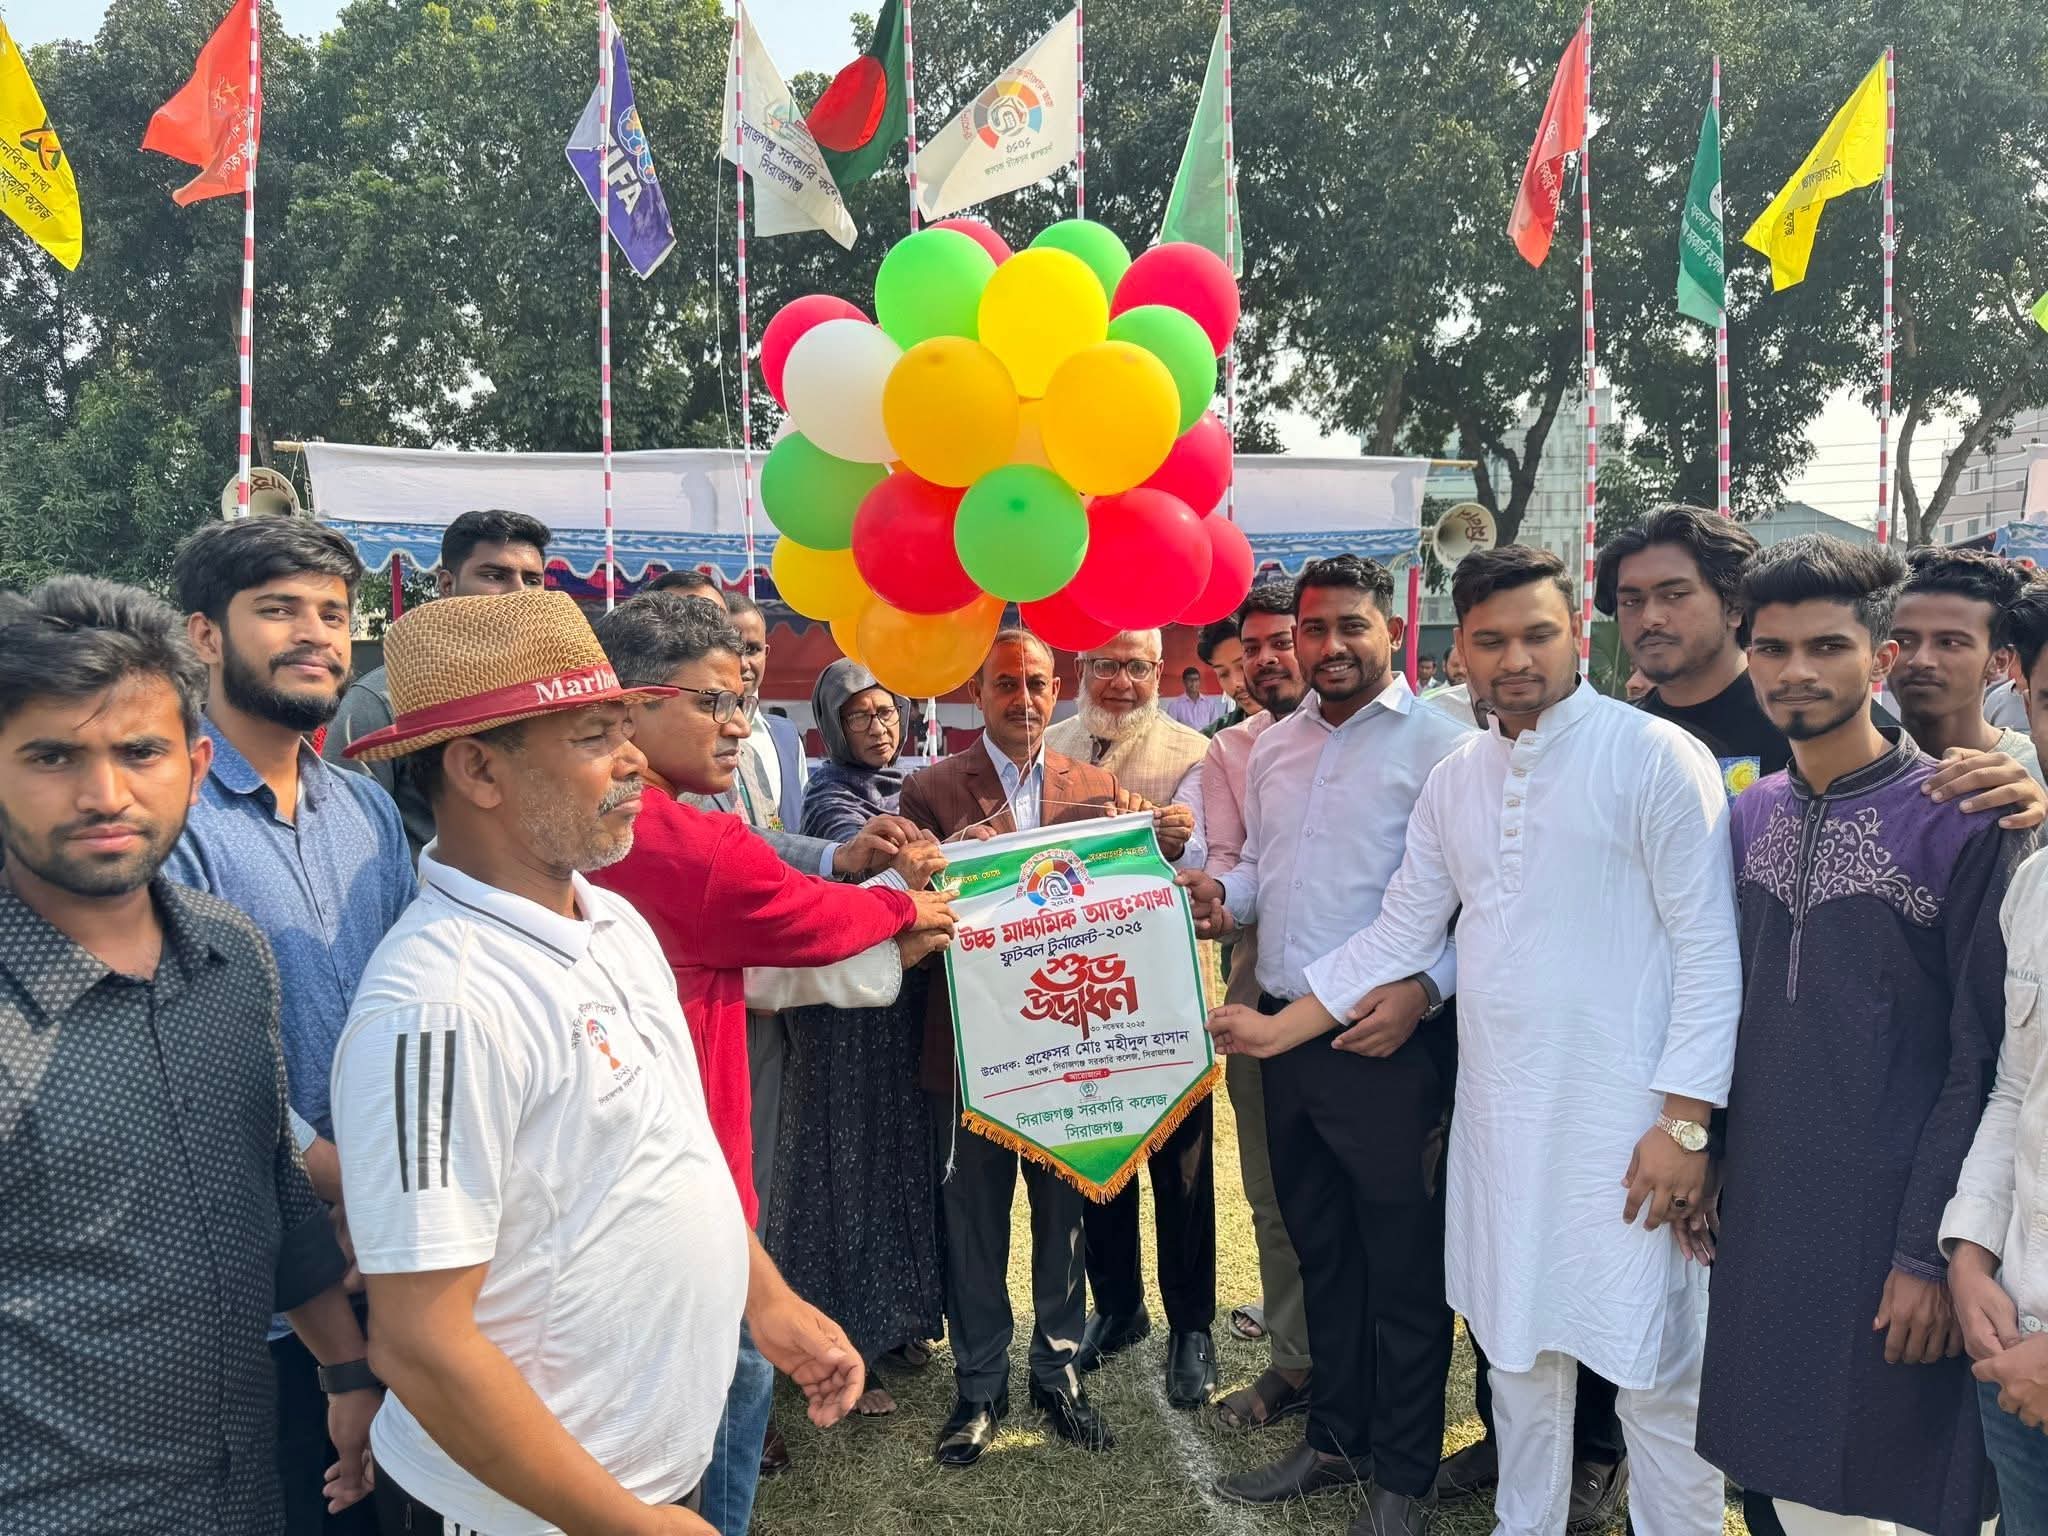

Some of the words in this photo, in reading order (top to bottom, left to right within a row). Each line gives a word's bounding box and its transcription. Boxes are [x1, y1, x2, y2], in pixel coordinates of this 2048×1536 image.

[608, 134, 643, 216] IFA
[759, 153, 804, 193] সিরাজগঞ্জ
[778, 146, 818, 181] সরকারি
[957, 926, 996, 951] উচ্চ
[1001, 908, 1077, 943] মাধ্যমিক
[1000, 943, 1045, 967] ফুটবল
[1048, 921, 1143, 956] টুর্নামেন্ট-২০২৫
[1030, 953, 1127, 993] শুভ
[1126, 1020, 1146, 1029] ২০২৫
[1024, 1044, 1071, 1065] প্রফেসর
[1075, 1040, 1101, 1055] মোঃ
[1105, 1033, 1148, 1052] মহীদুল
[1151, 1030, 1190, 1047] হাসান
[1053, 1059, 1085, 1071] সিরাজগঞ্জ
[1088, 1055, 1114, 1065] সরকারি
[1143, 1048, 1176, 1059] সিরাজগঞ্জ
[1016, 1105, 1075, 1129] সিরাজগঞ্জ
[1078, 1096, 1124, 1117] সরকারি
[1126, 1093, 1169, 1109] কলেজ
[1064, 1121, 1124, 1141] সিরাজগঞ্জ
